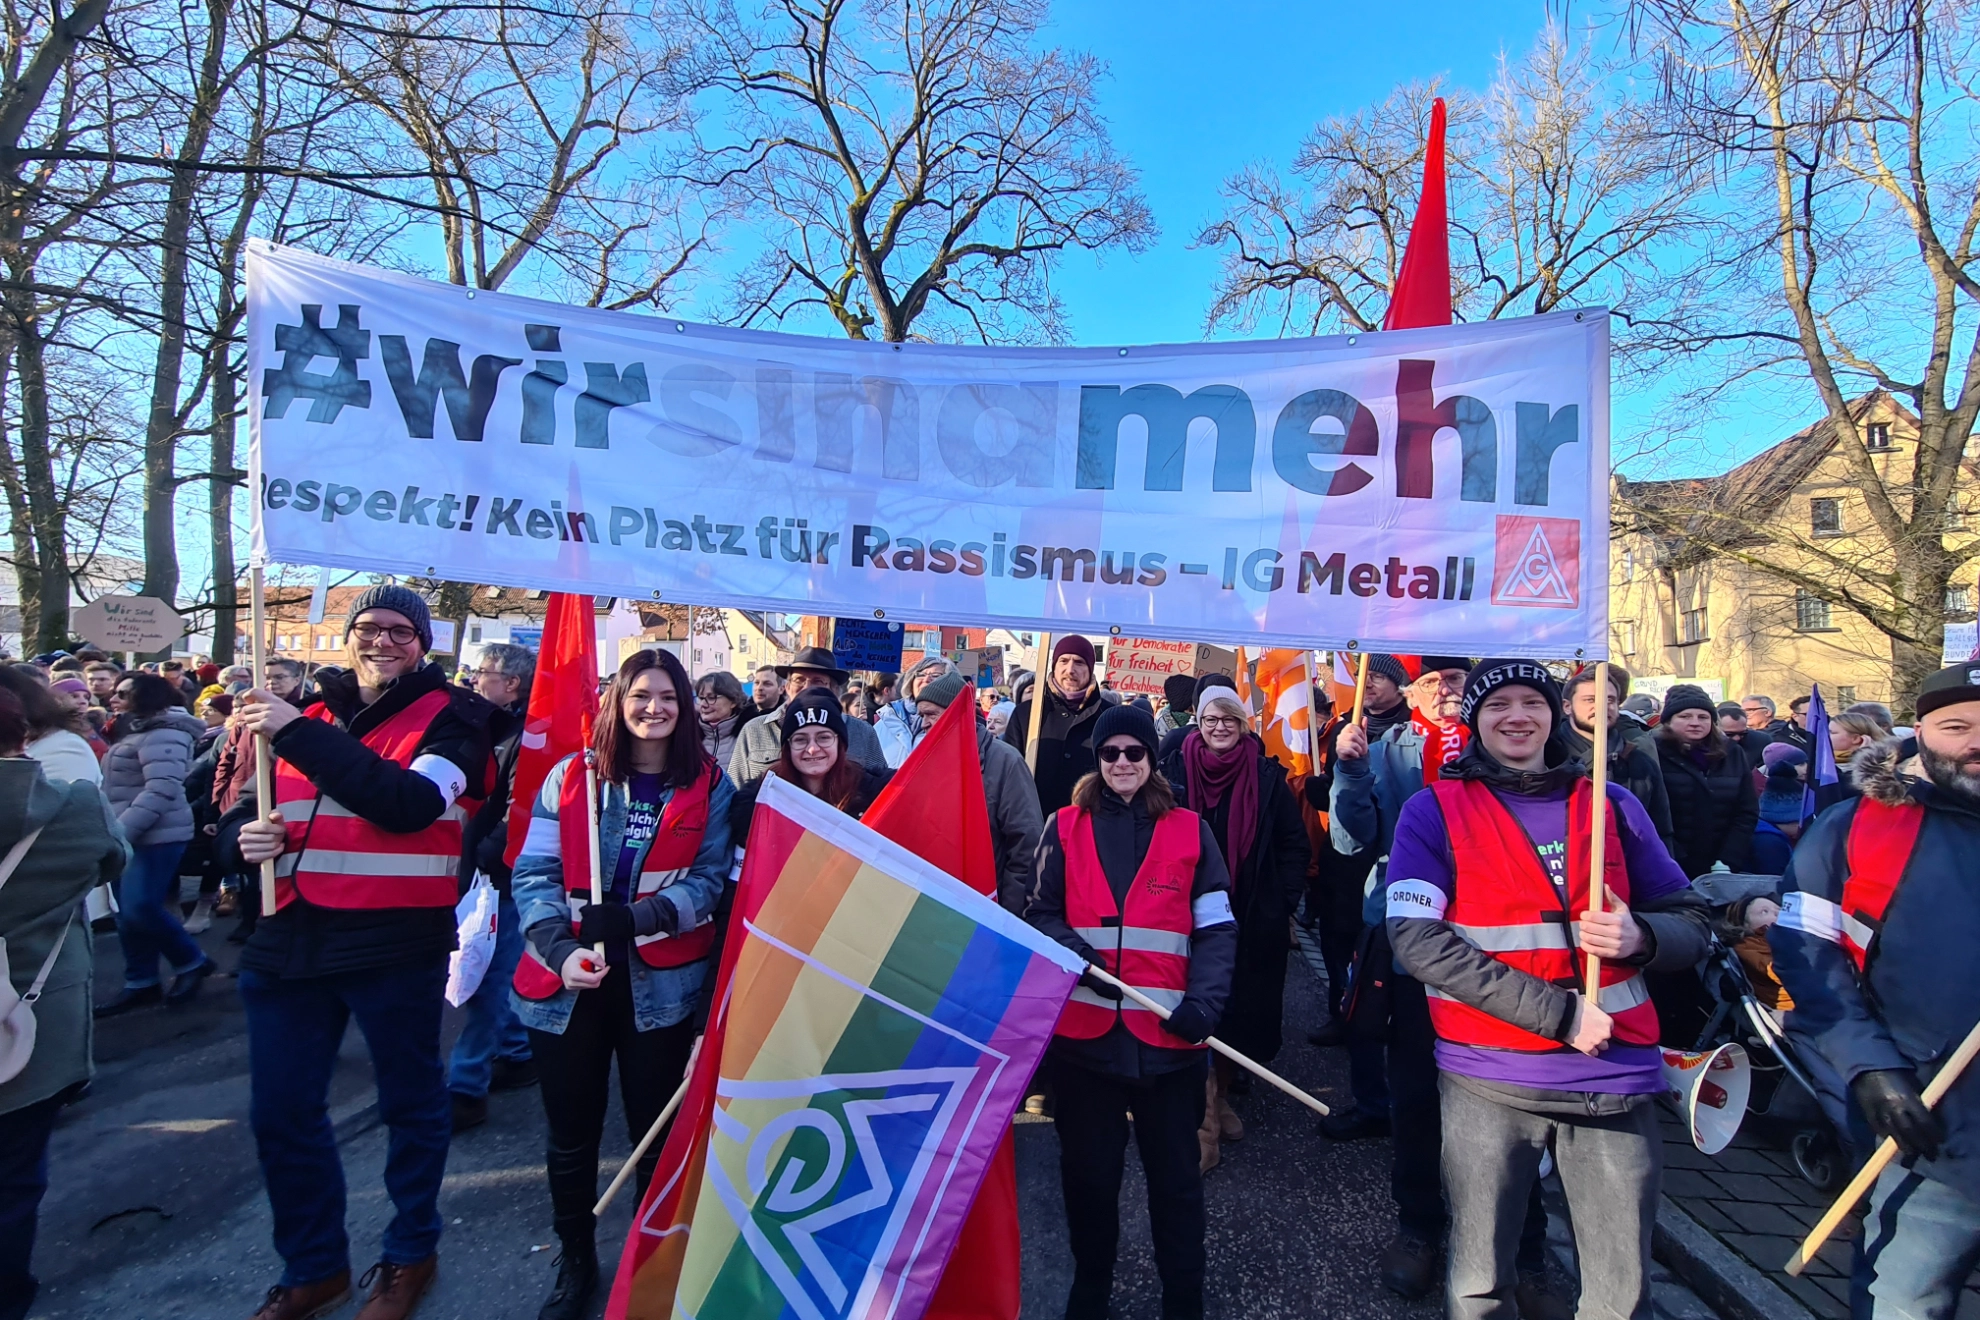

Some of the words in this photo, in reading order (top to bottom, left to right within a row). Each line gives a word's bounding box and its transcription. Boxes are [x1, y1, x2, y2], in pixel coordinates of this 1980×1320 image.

[487, 496, 599, 545] Kein
[609, 506, 747, 556] Platz
[756, 515, 839, 565] für
[852, 524, 1168, 587] Rassismus
[1222, 547, 1284, 592] IG
[1299, 551, 1475, 601] Metall
[1132, 637, 1193, 654] Demokratie
[1944, 650, 1971, 659] BUNDE
[1109, 650, 1125, 669] Für
[1128, 652, 1174, 673] Freiheit
[1460, 663, 1548, 723] HOLLISTER
[794, 707, 829, 727] BAD
[1392, 890, 1432, 908] ORDNER
